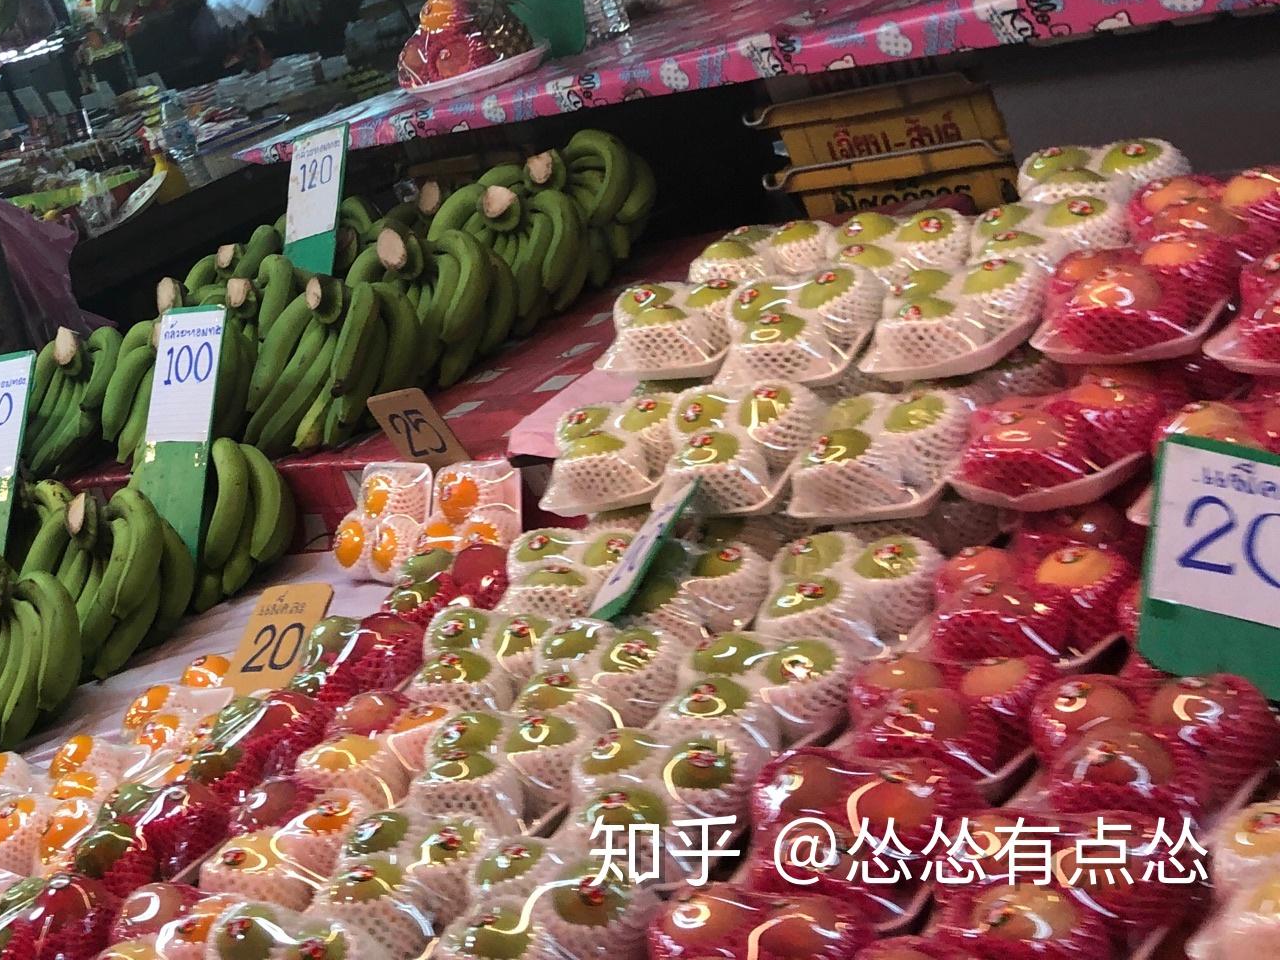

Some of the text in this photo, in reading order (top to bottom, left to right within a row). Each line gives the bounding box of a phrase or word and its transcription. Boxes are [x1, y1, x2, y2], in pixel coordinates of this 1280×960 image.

[300, 154, 333, 193] 120
[164, 341, 213, 385] 100
[388, 408, 448, 458] 25
[240, 622, 306, 673] 20
